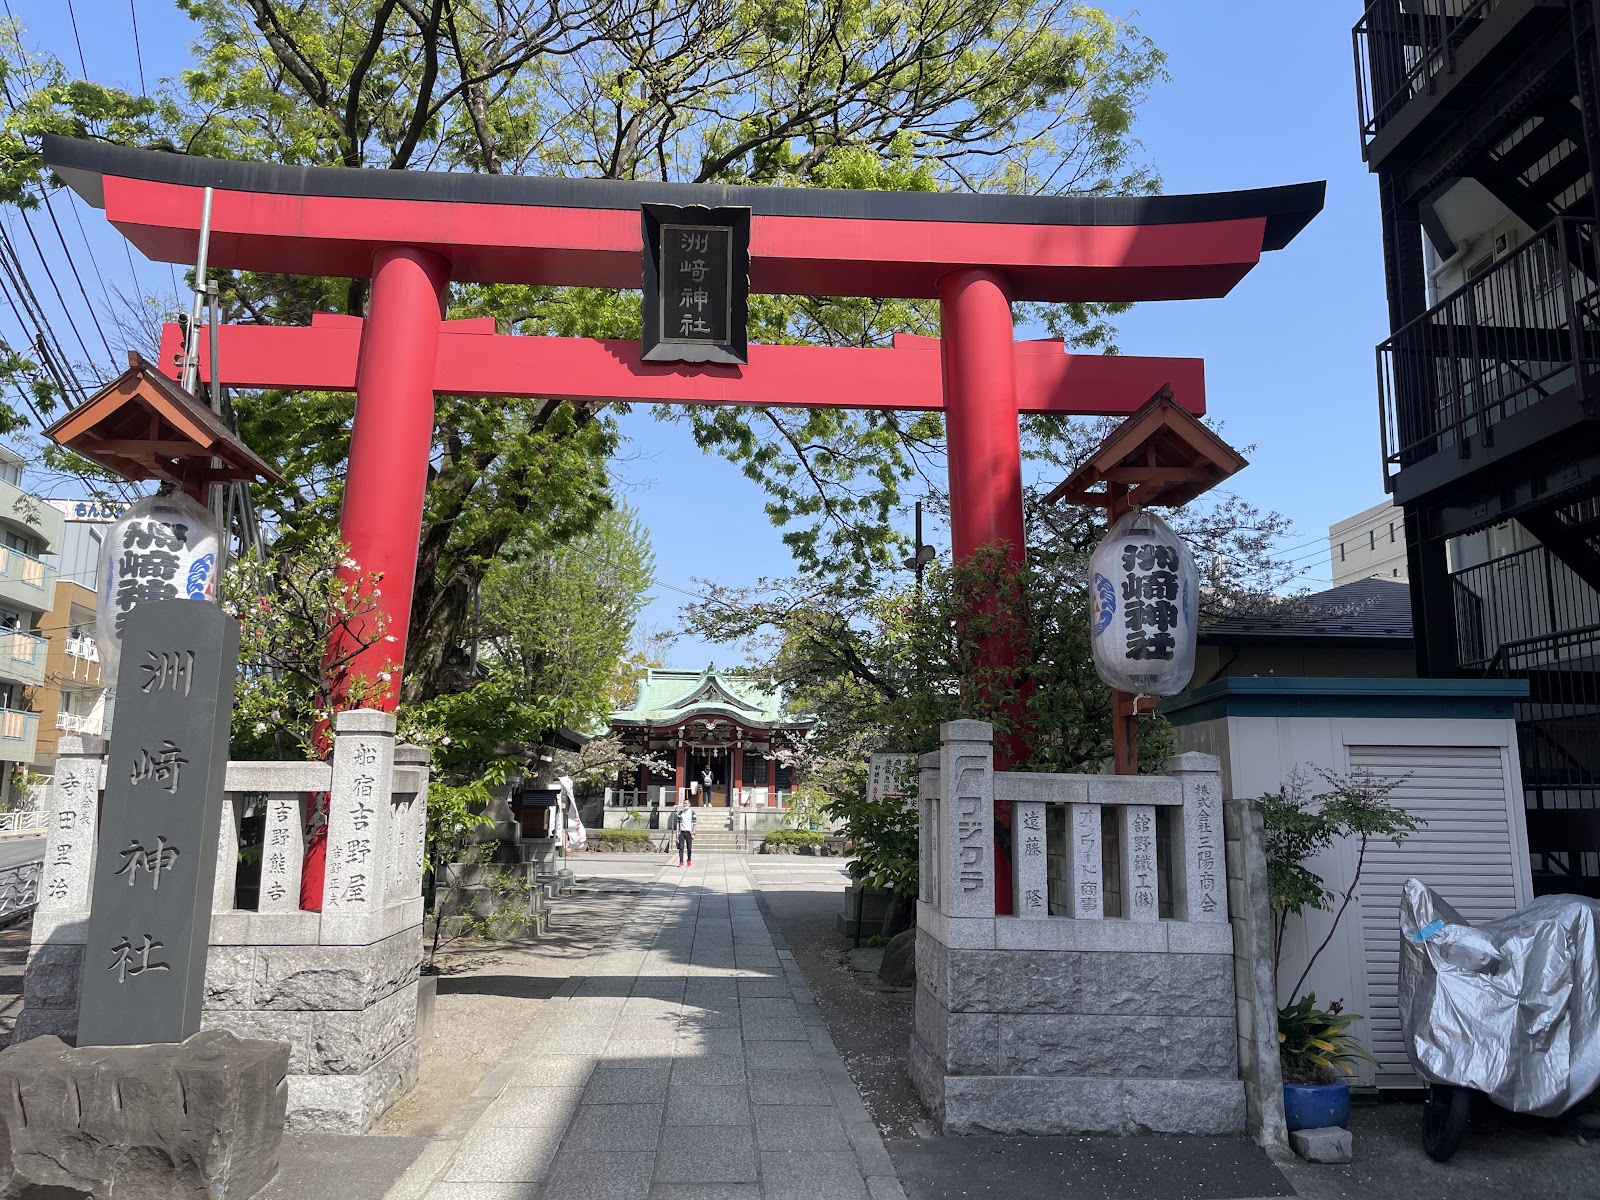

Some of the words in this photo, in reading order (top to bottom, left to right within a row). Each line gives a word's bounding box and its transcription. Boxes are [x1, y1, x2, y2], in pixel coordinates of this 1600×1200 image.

[341, 743, 376, 903] 船宿吉野屋
[1079, 809, 1098, 913] オンワード商事
[1195, 784, 1218, 913] 株式会社三陽商会
